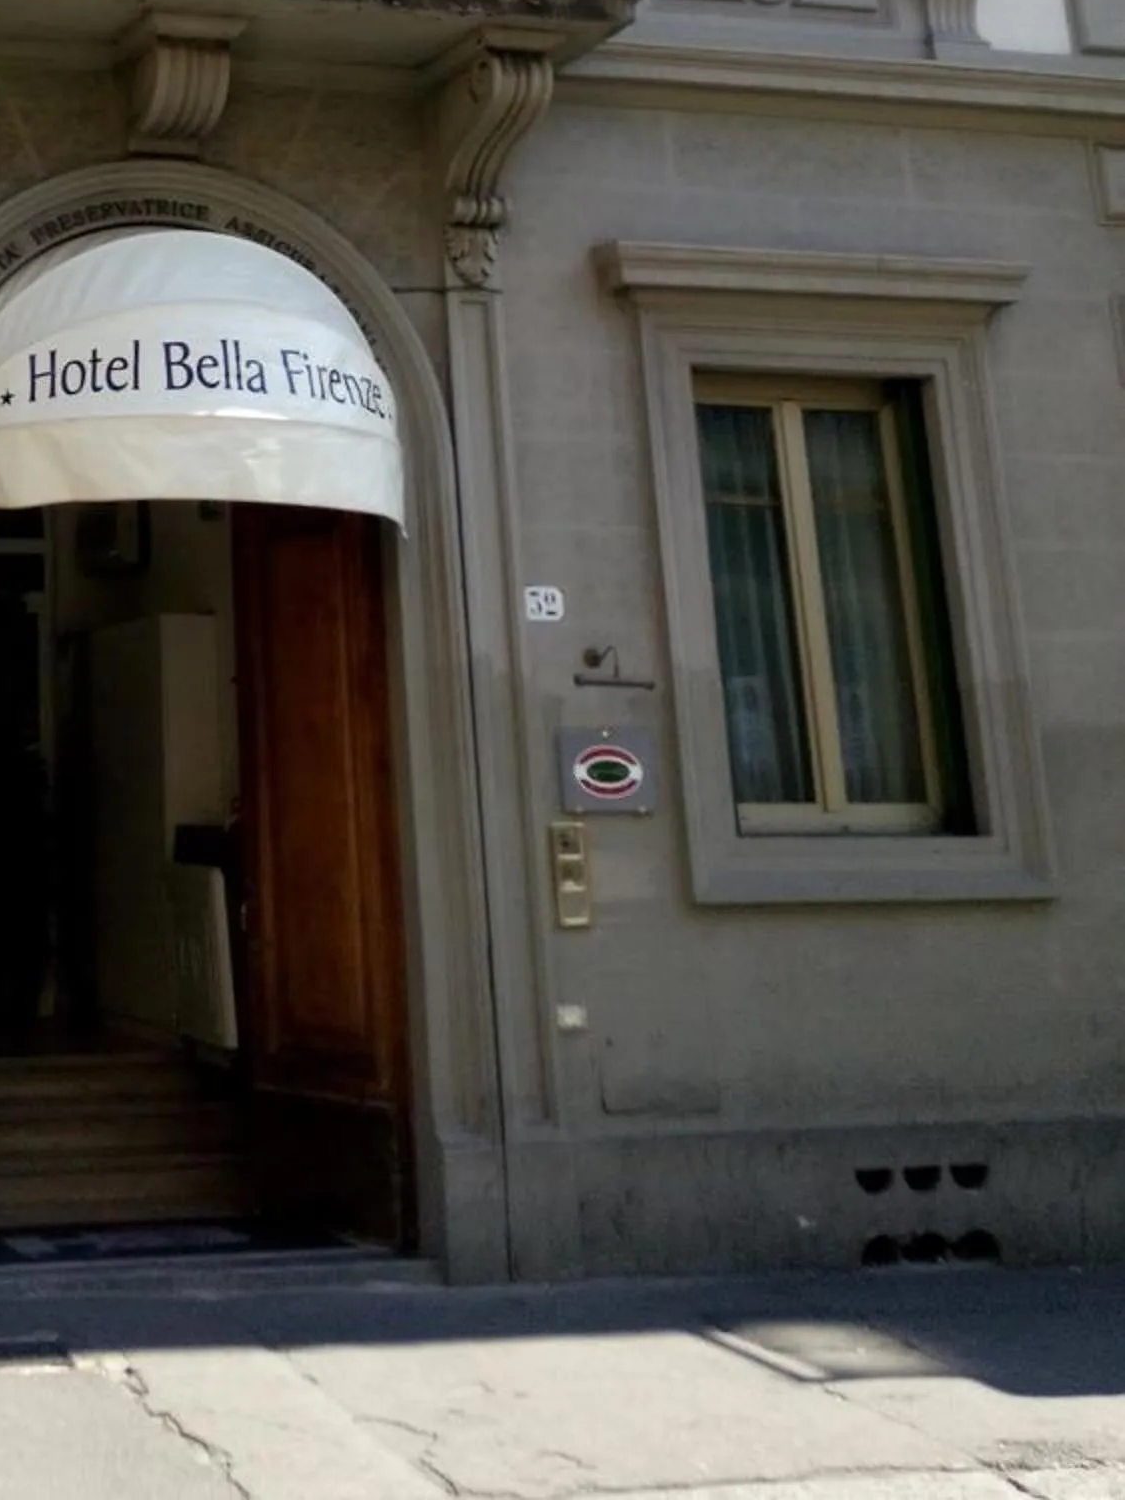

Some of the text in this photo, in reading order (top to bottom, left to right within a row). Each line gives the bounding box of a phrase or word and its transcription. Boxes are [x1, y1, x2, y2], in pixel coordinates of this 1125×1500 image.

[29, 198, 209, 246] PRESERVATRICE
[29, 340, 139, 402] Hotel
[163, 340, 267, 393] Bella
[280, 349, 386, 418] Firenze
